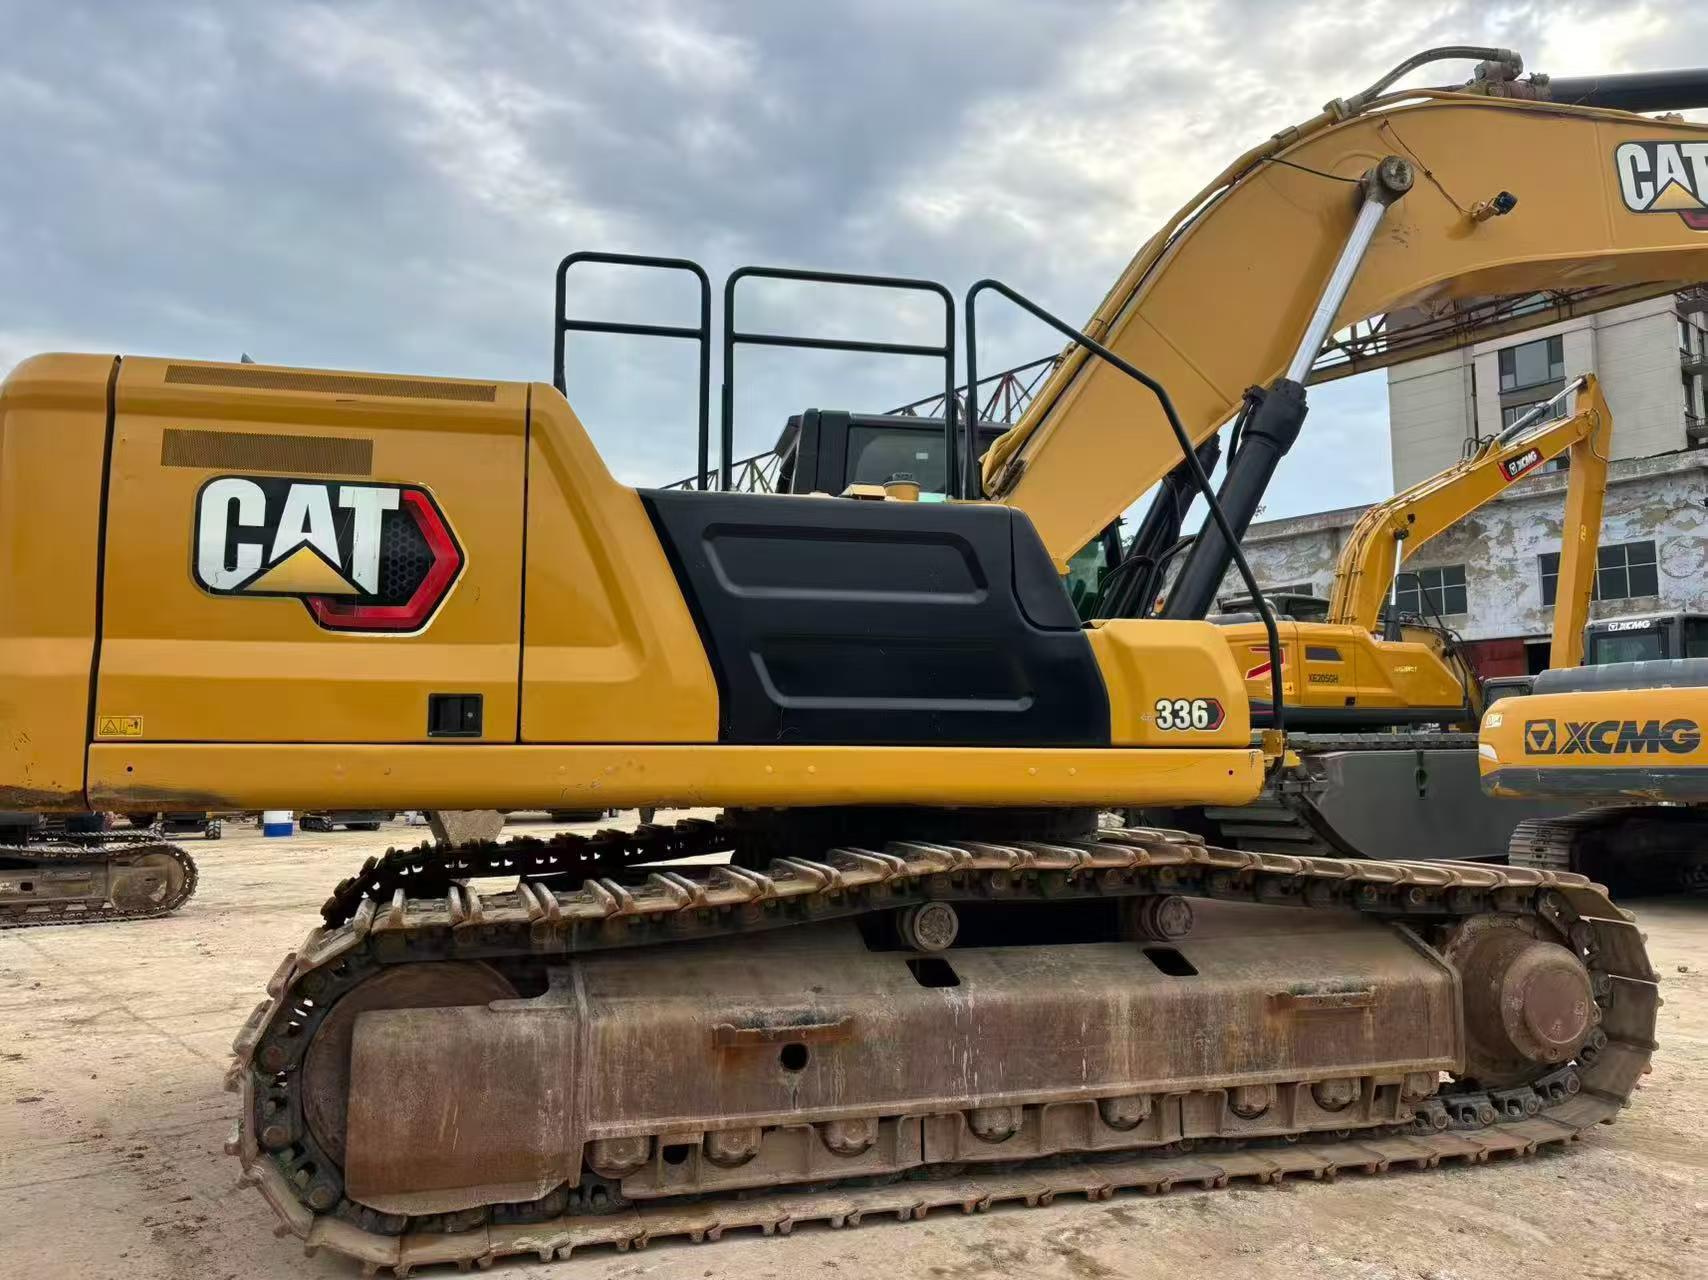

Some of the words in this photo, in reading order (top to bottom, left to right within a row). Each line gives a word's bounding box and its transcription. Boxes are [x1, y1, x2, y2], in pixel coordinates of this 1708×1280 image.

[1617, 143, 1708, 211] CAT
[198, 477, 400, 595] CAT
[1617, 620, 1650, 631] XCMG
[1156, 699, 1209, 730] 336
[1557, 718, 1701, 755] XCMG
